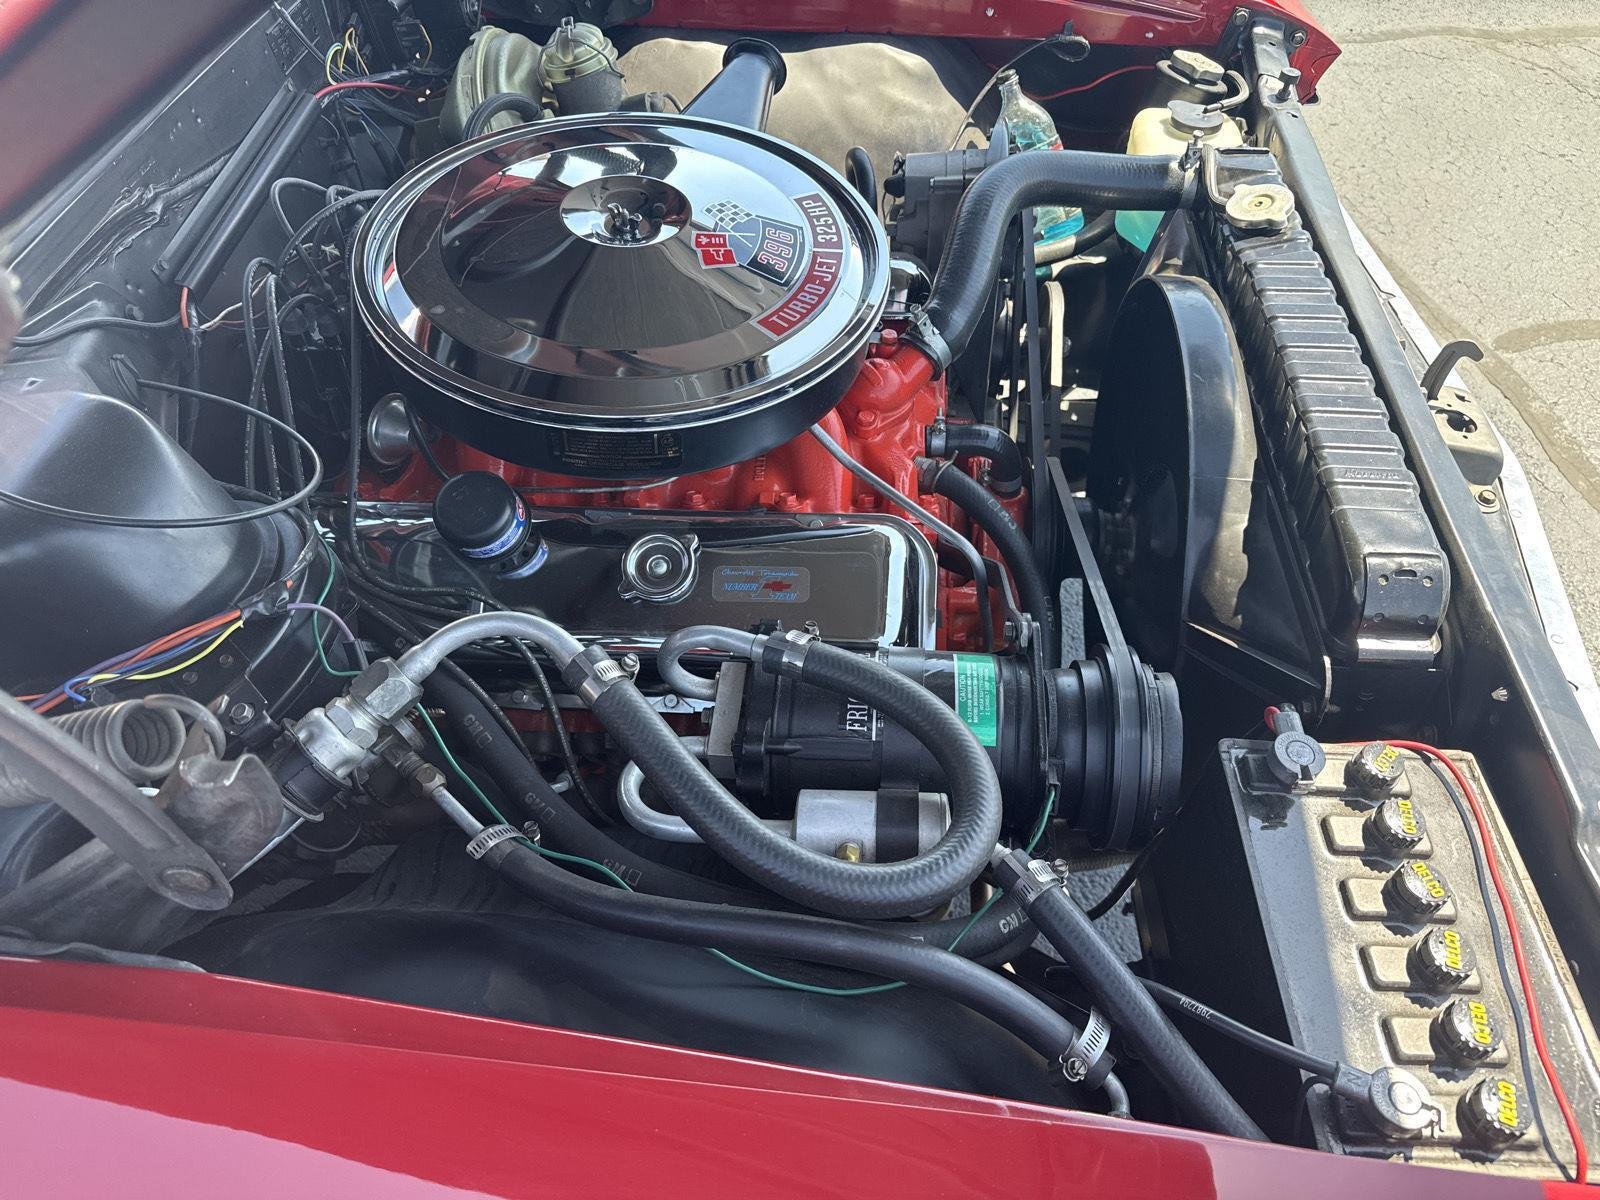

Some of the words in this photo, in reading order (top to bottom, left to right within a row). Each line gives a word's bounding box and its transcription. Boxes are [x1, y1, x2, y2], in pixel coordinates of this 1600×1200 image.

[802, 199, 838, 244] 325HP
[757, 227, 795, 272] 396
[768, 255, 838, 329] TURBO-JET
[959, 674, 967, 702] CAUTION
[1397, 799, 1418, 835] DELCO
[1411, 861, 1445, 898] DELCO
[999, 914, 1018, 934] GM
[1443, 930, 1463, 970] DELCO
[1468, 1001, 1493, 1044] DELCO
[1497, 1081, 1519, 1127] DELCO
